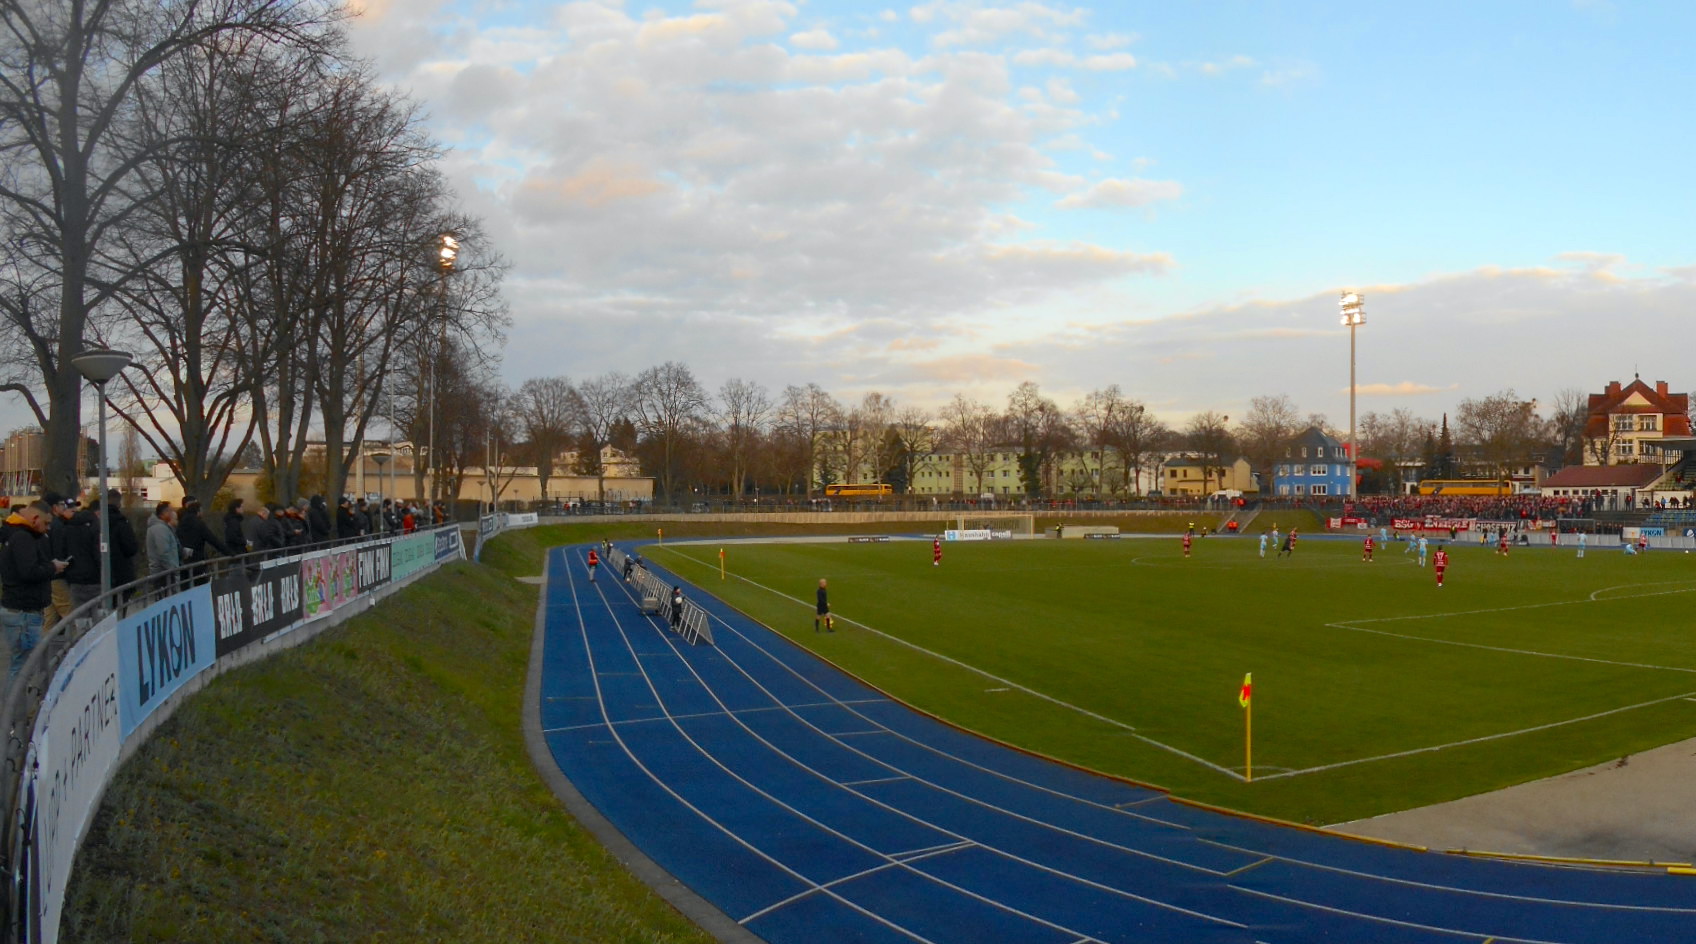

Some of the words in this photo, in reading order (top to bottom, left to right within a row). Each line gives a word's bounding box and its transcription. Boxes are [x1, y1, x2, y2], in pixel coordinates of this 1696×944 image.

[1436, 551, 1445, 560] 17
[136, 600, 196, 707] LYKON
[70, 672, 118, 791] PARTNER
